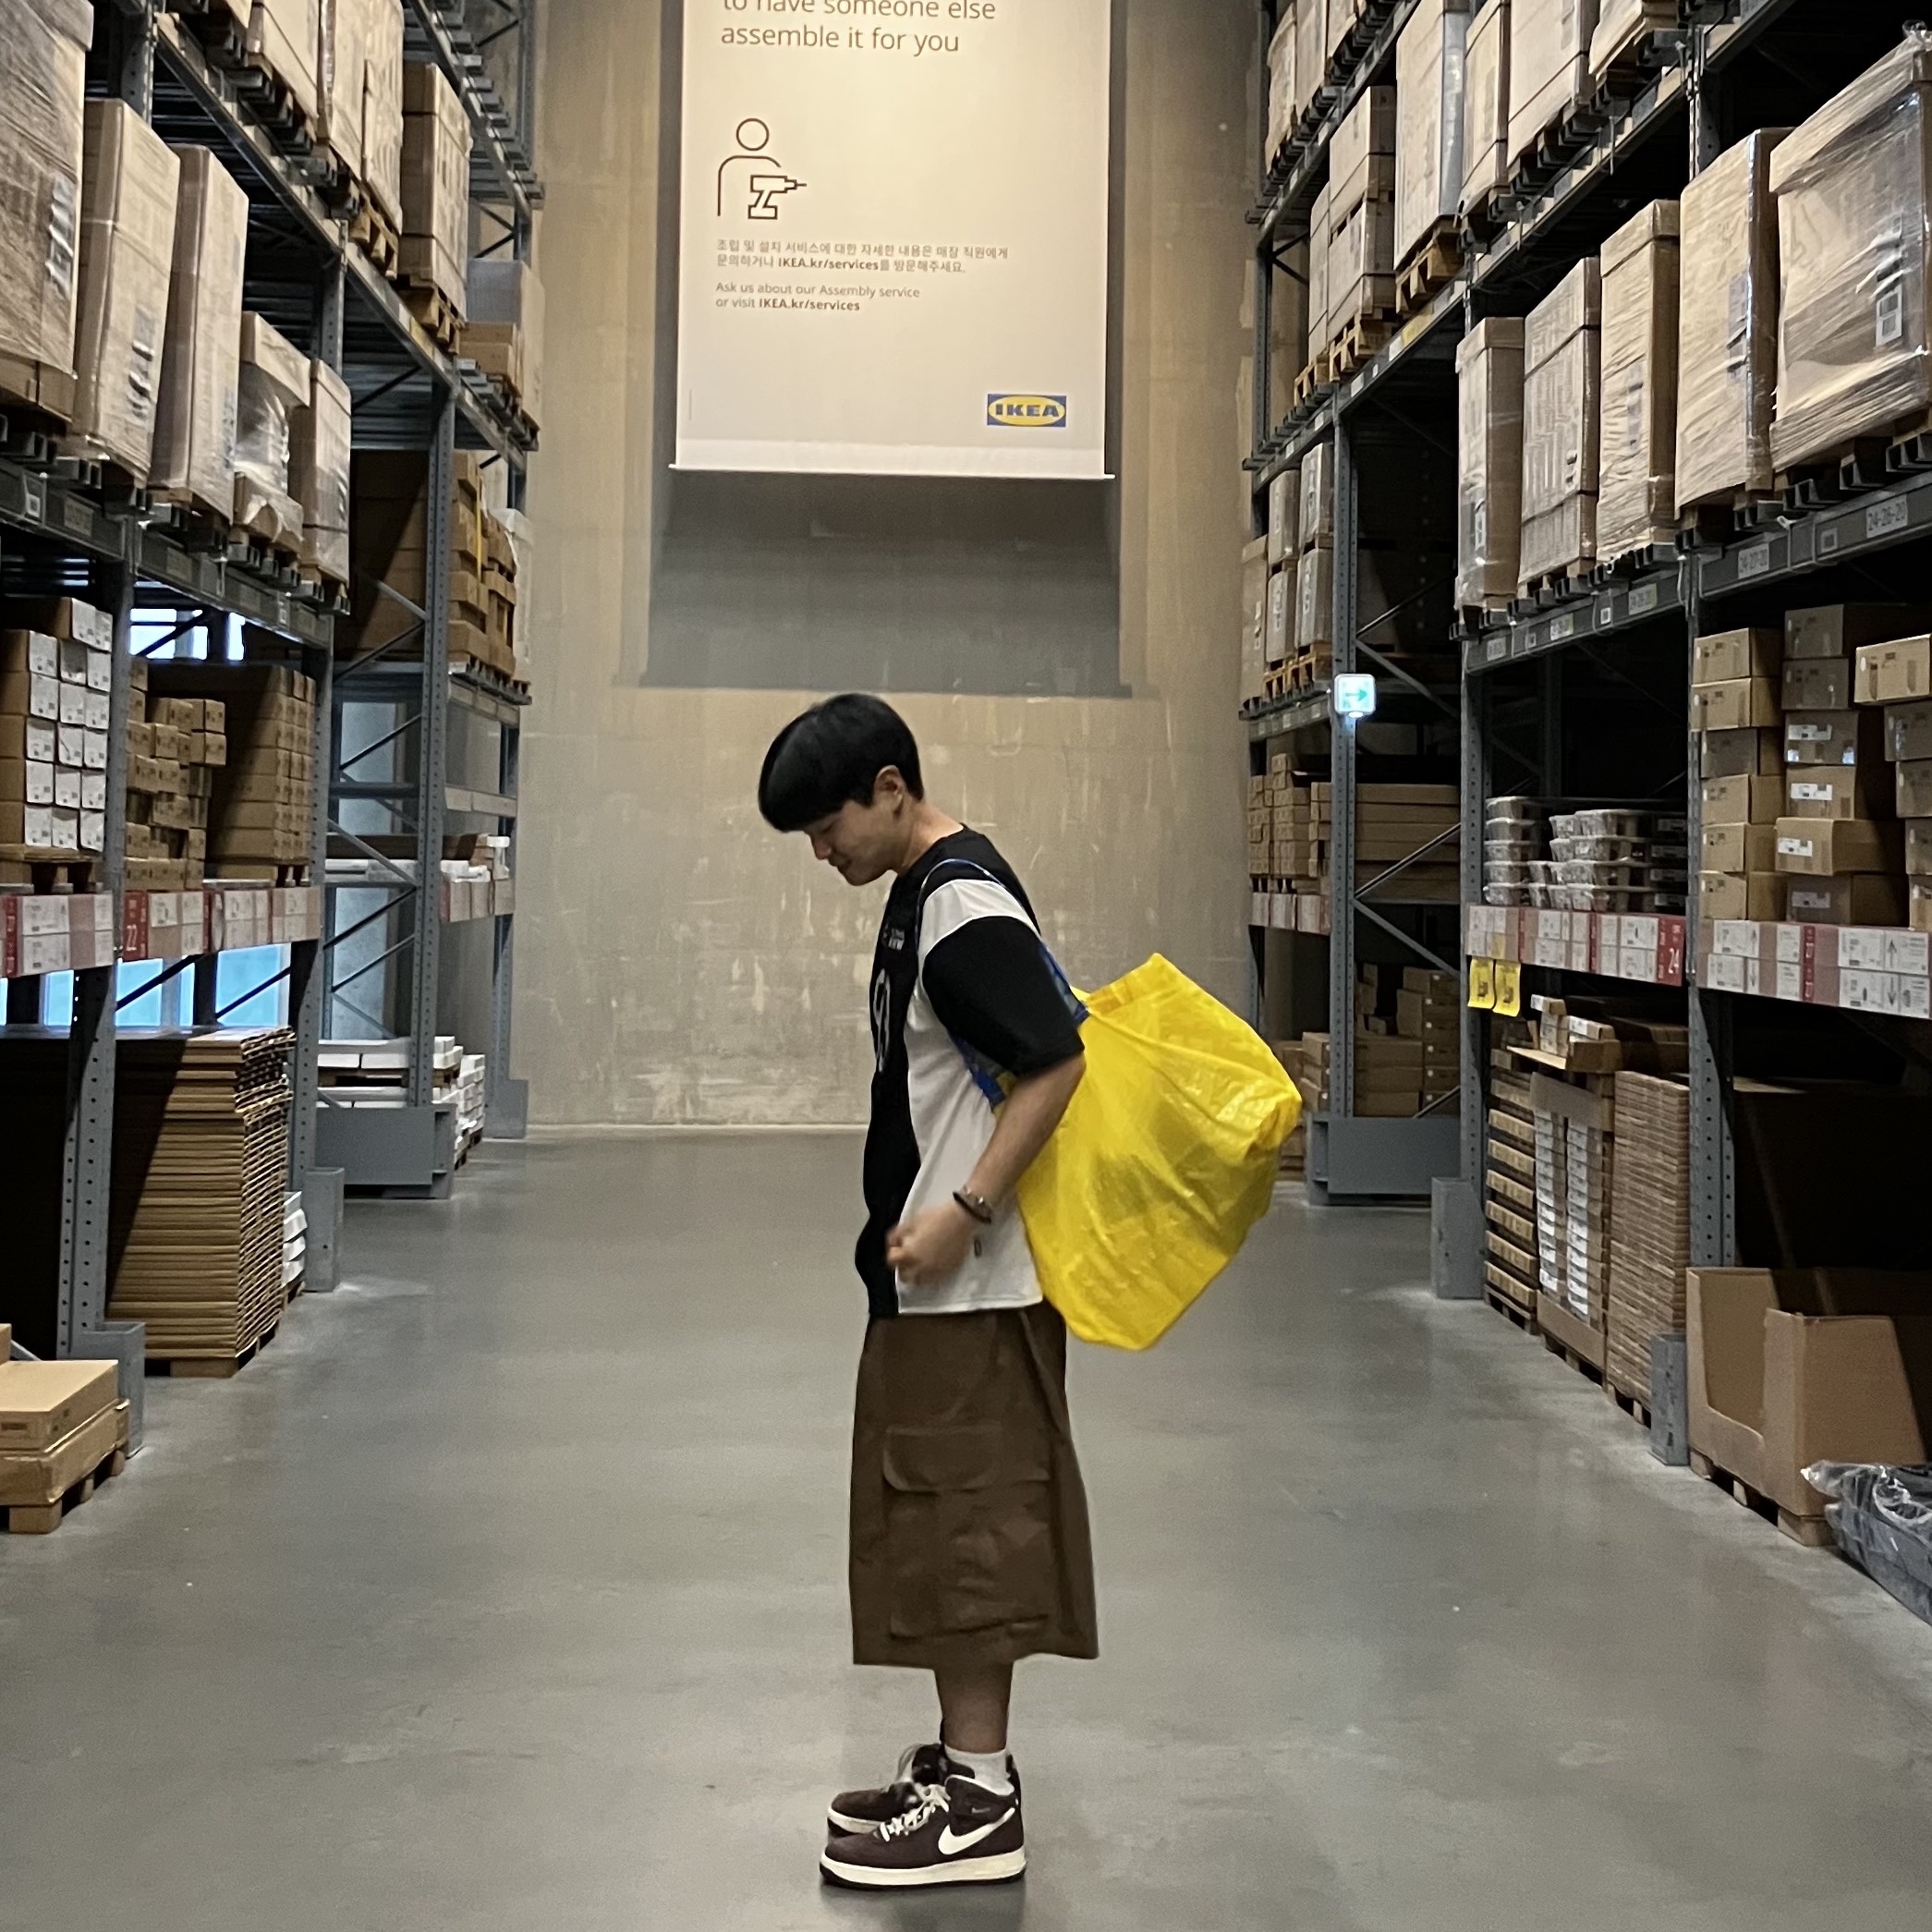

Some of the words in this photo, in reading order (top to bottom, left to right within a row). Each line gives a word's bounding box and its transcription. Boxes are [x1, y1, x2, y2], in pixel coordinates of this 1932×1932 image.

[723, 0, 747, 11] to
[823, 0, 940, 18] someone
[947, 0, 996, 19] else
[721, 23, 840, 48] assemble
[848, 26, 864, 49] it
[871, 27, 907, 50] for
[913, 34, 959, 57] you
[717, 238, 739, 252] 조립
[743, 239, 755, 252] 및
[785, 241, 831, 255] 서비스에
[834, 243, 857, 256] 대한
[861, 243, 894, 257] 자세한
[898, 244, 931, 258] 내용은
[936, 246, 958, 259] 매장
[963, 246, 1009, 260] 직원에게
[717, 253, 774, 268] 문의하거나
[893, 259, 966, 273] 방문해주세요.
[715, 282, 736, 293] Ask
[740, 284, 755, 293] us
[757, 284, 793, 295] about
[796, 286, 817, 295] our
[819, 285, 876, 299] Assembly
[879, 287, 920, 298] service
[715, 298, 729, 308] or
[731, 298, 756, 309] visit
[759, 298, 860, 310] IKEA.kr/services
[995, 403, 1060, 417] IKEA
[1668, 947, 1680, 975] 24
